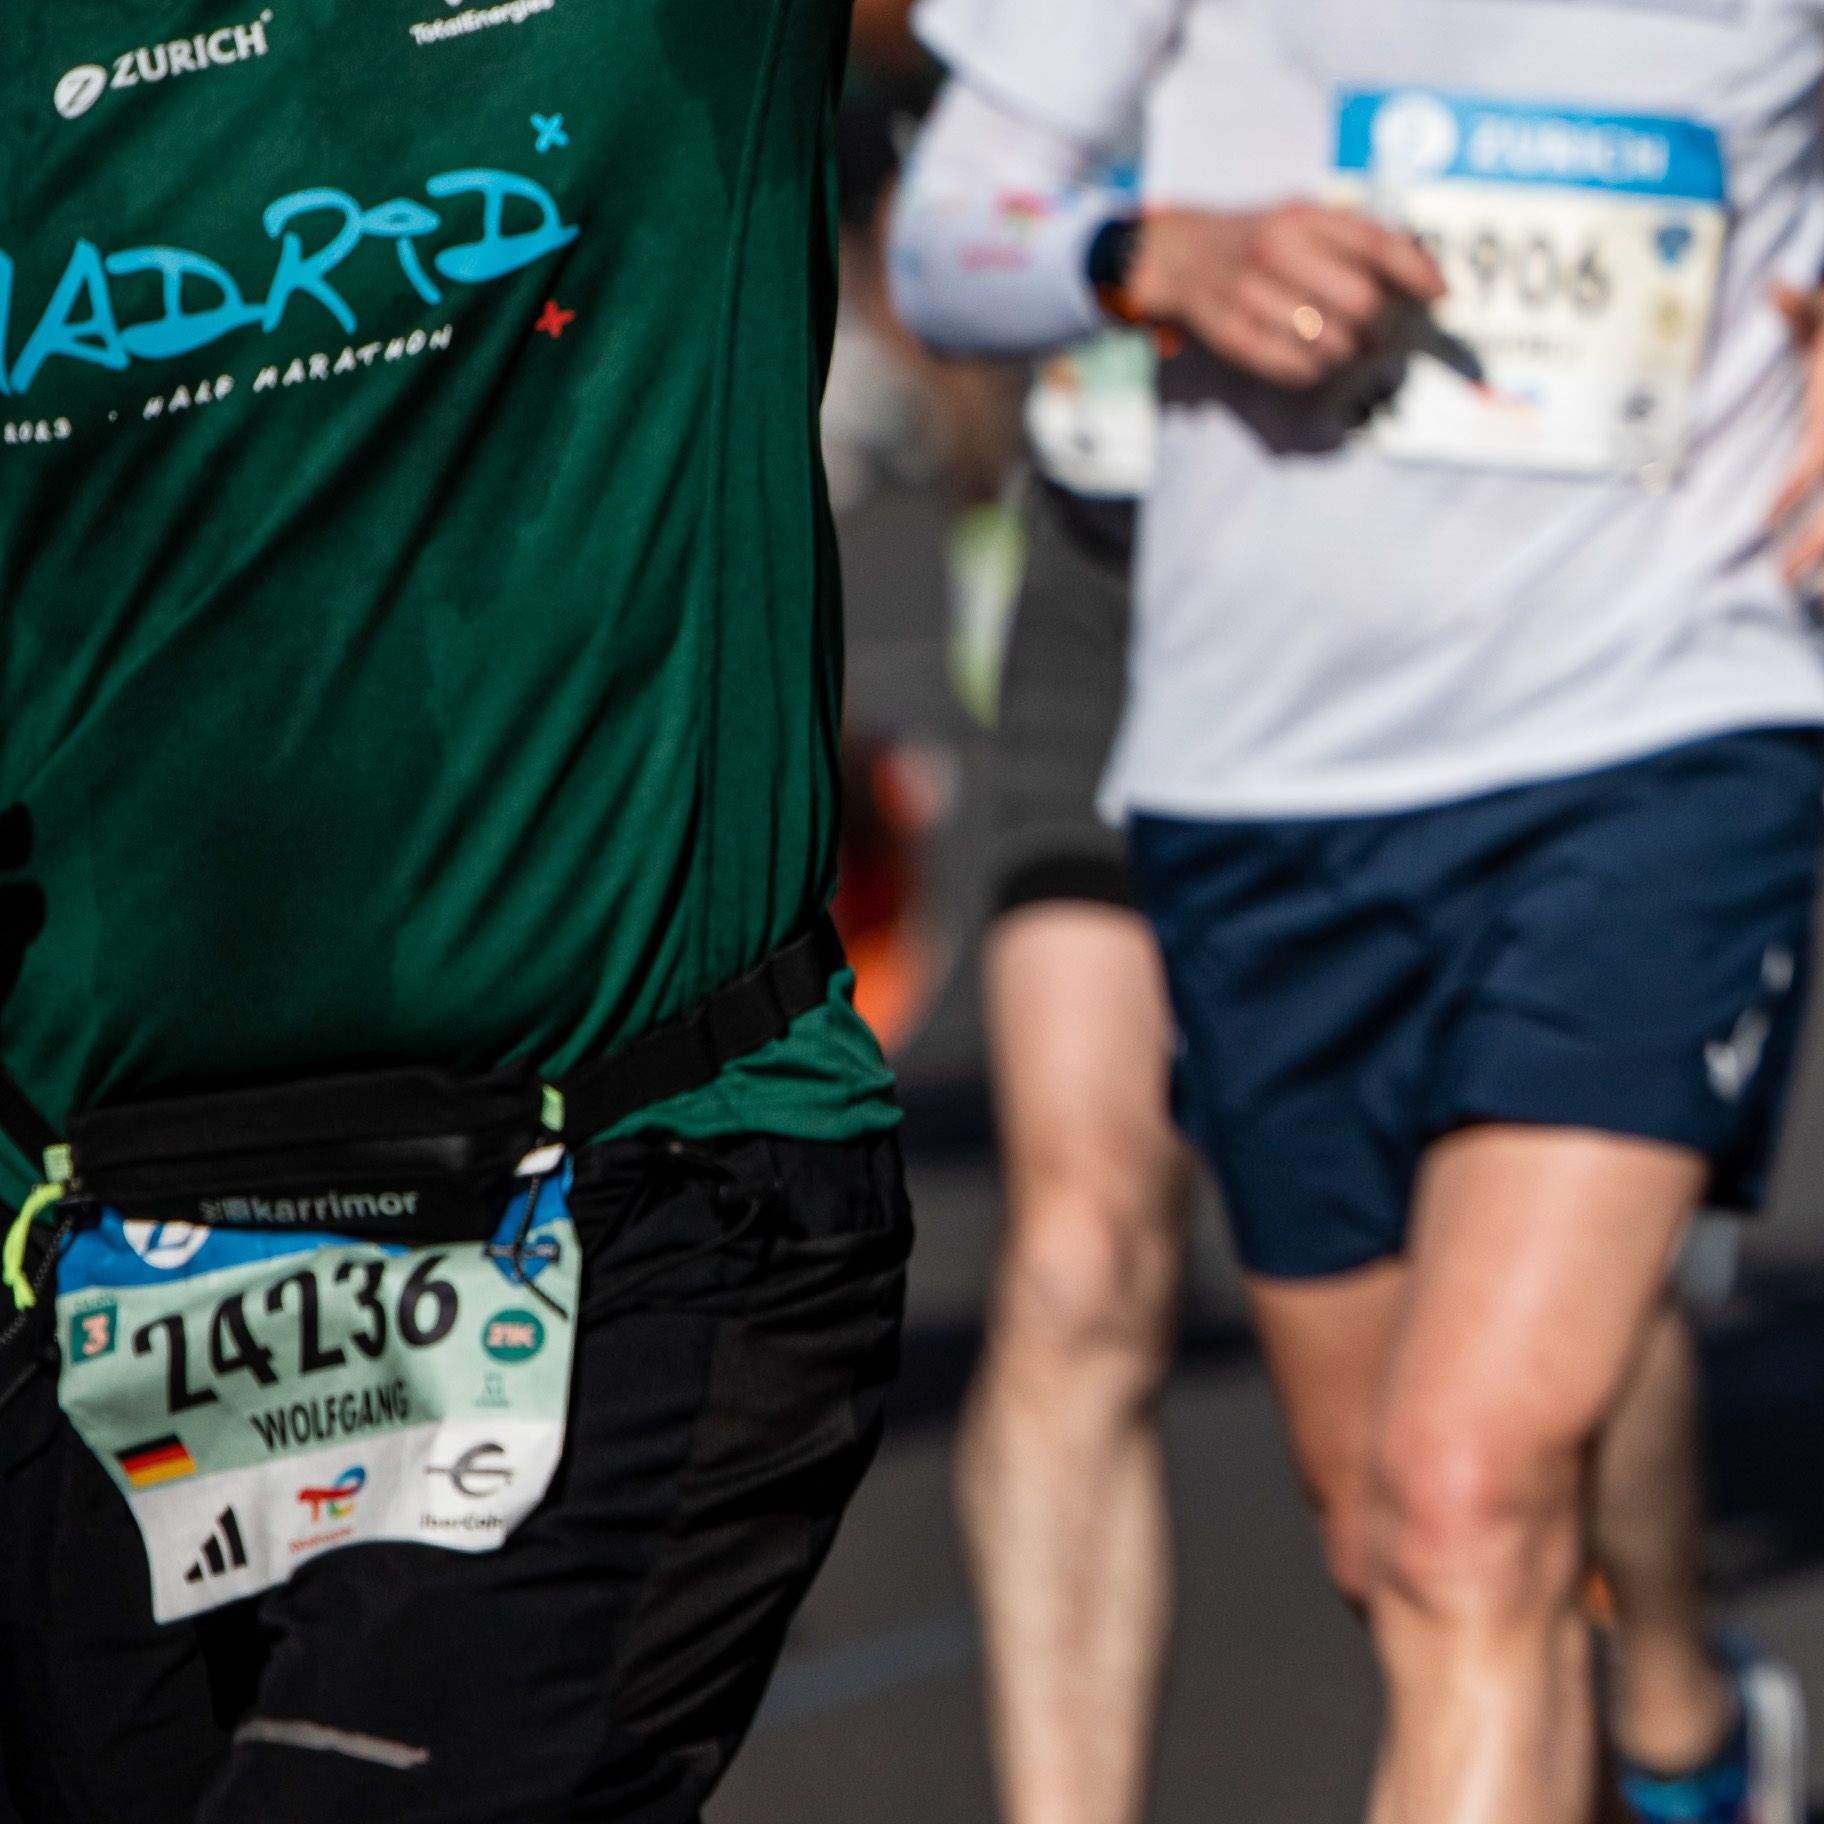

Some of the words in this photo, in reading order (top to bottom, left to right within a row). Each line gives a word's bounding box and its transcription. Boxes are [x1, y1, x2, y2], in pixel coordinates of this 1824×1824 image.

[112, 22, 269, 91] ZURICH
[0, 167, 579, 395] ADRID
[142, 373, 235, 420] HALF
[253, 324, 452, 393] MARATHON
[82, 1314, 109, 1355] 3
[133, 1253, 458, 1415] 24236
[250, 1380, 409, 1453] WOLFGANG
